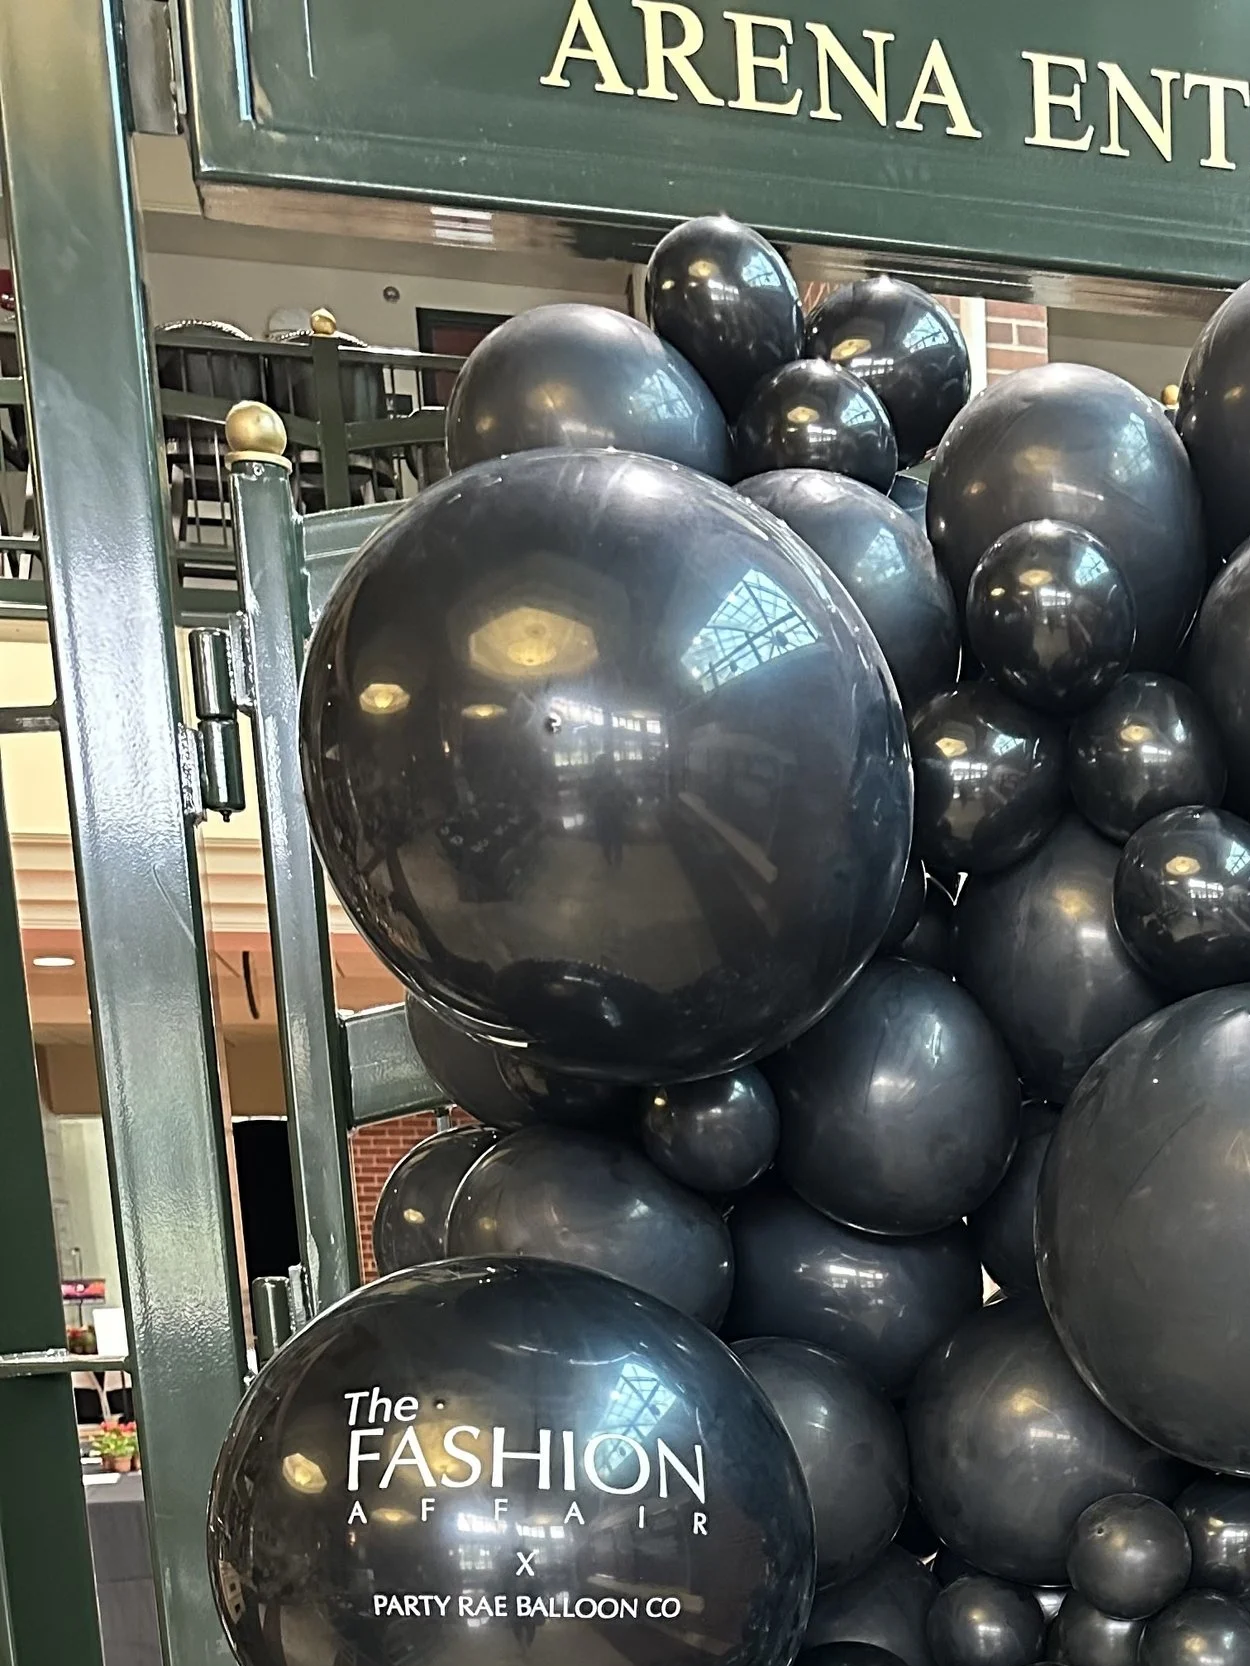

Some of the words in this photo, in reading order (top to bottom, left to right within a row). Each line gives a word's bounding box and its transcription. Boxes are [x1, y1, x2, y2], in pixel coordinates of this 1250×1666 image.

[539, 0, 983, 140] ARENA
[344, 1387, 418, 1426] The
[347, 1425, 707, 1504] FASHION
[347, 1498, 708, 1535] AFFAIR
[515, 1552, 536, 1577] X
[373, 1594, 451, 1617] PARTY
[458, 1596, 507, 1617] RAE
[516, 1596, 639, 1618] BALLOON
[645, 1597, 681, 1619] CO
